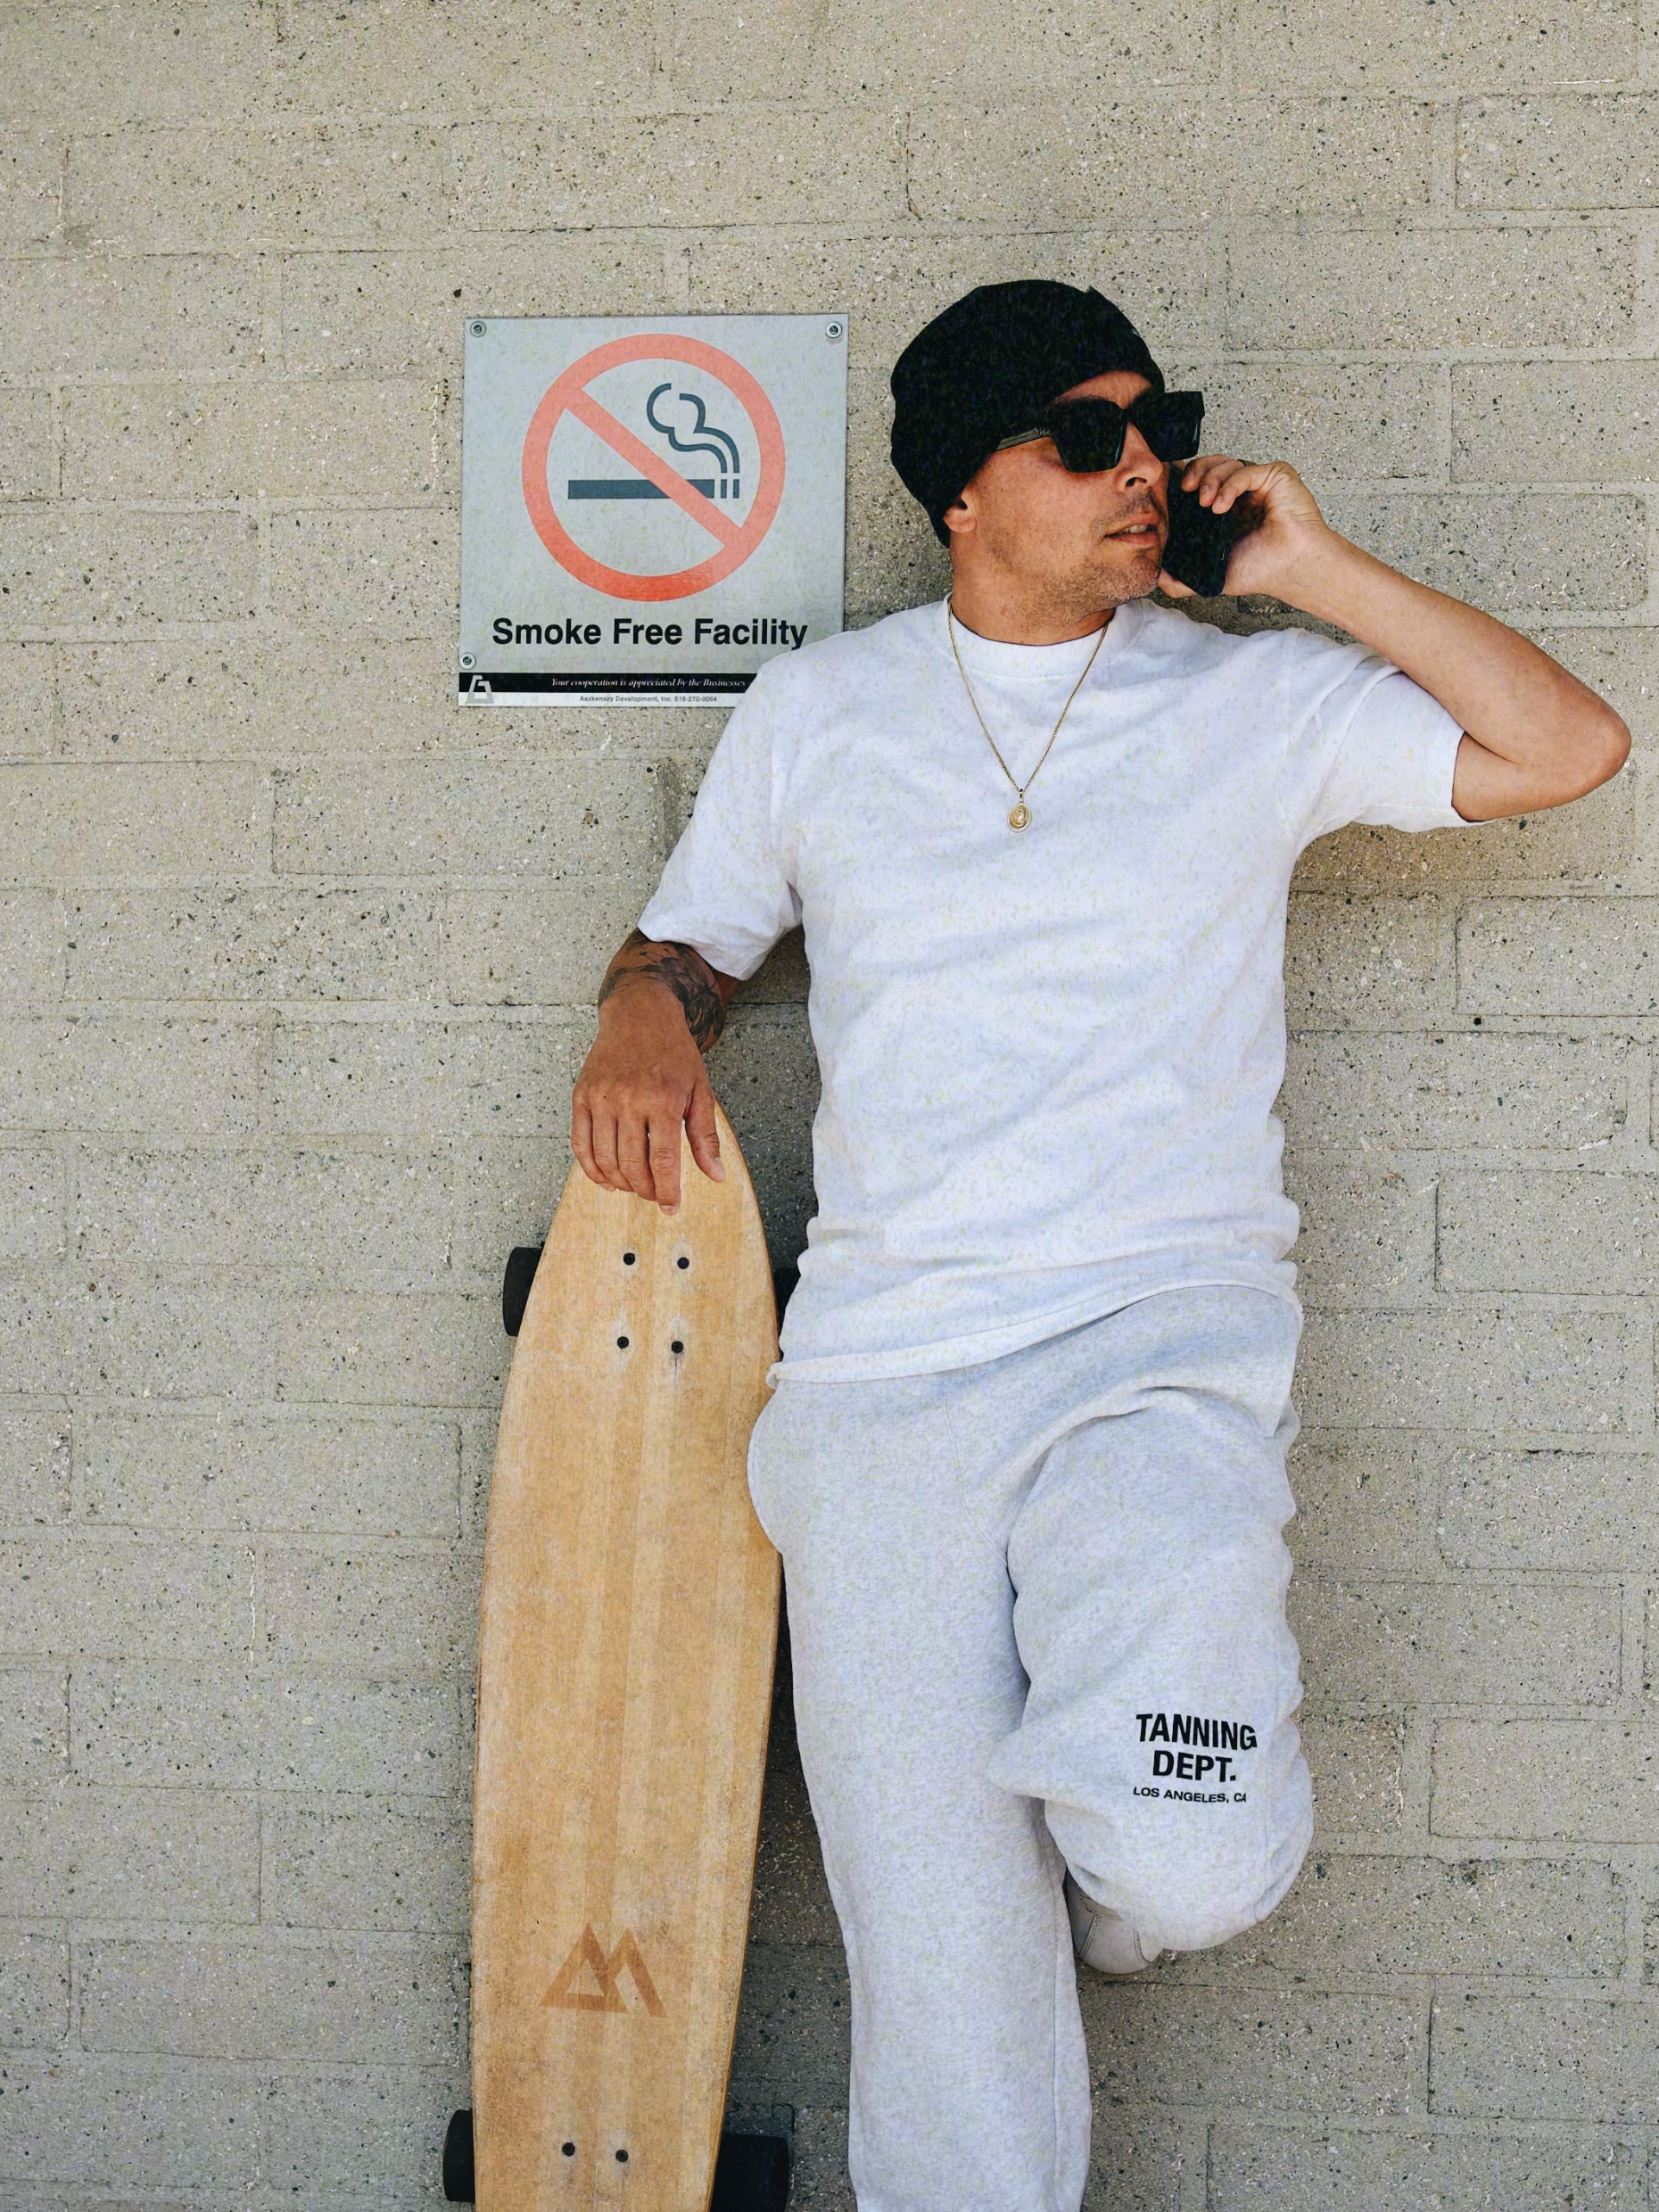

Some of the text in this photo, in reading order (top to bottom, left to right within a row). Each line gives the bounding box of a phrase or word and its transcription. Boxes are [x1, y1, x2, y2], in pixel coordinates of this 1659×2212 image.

[492, 617, 808, 651] Smoke Free Facility
[552, 678, 746, 689] Your cooperation is appreciated by the Businesses
[1135, 1713, 1258, 1751] TANNING
[1152, 1750, 1236, 1783] DEPT.
[1133, 1787, 1247, 1803] LOS ANGELES, CA
